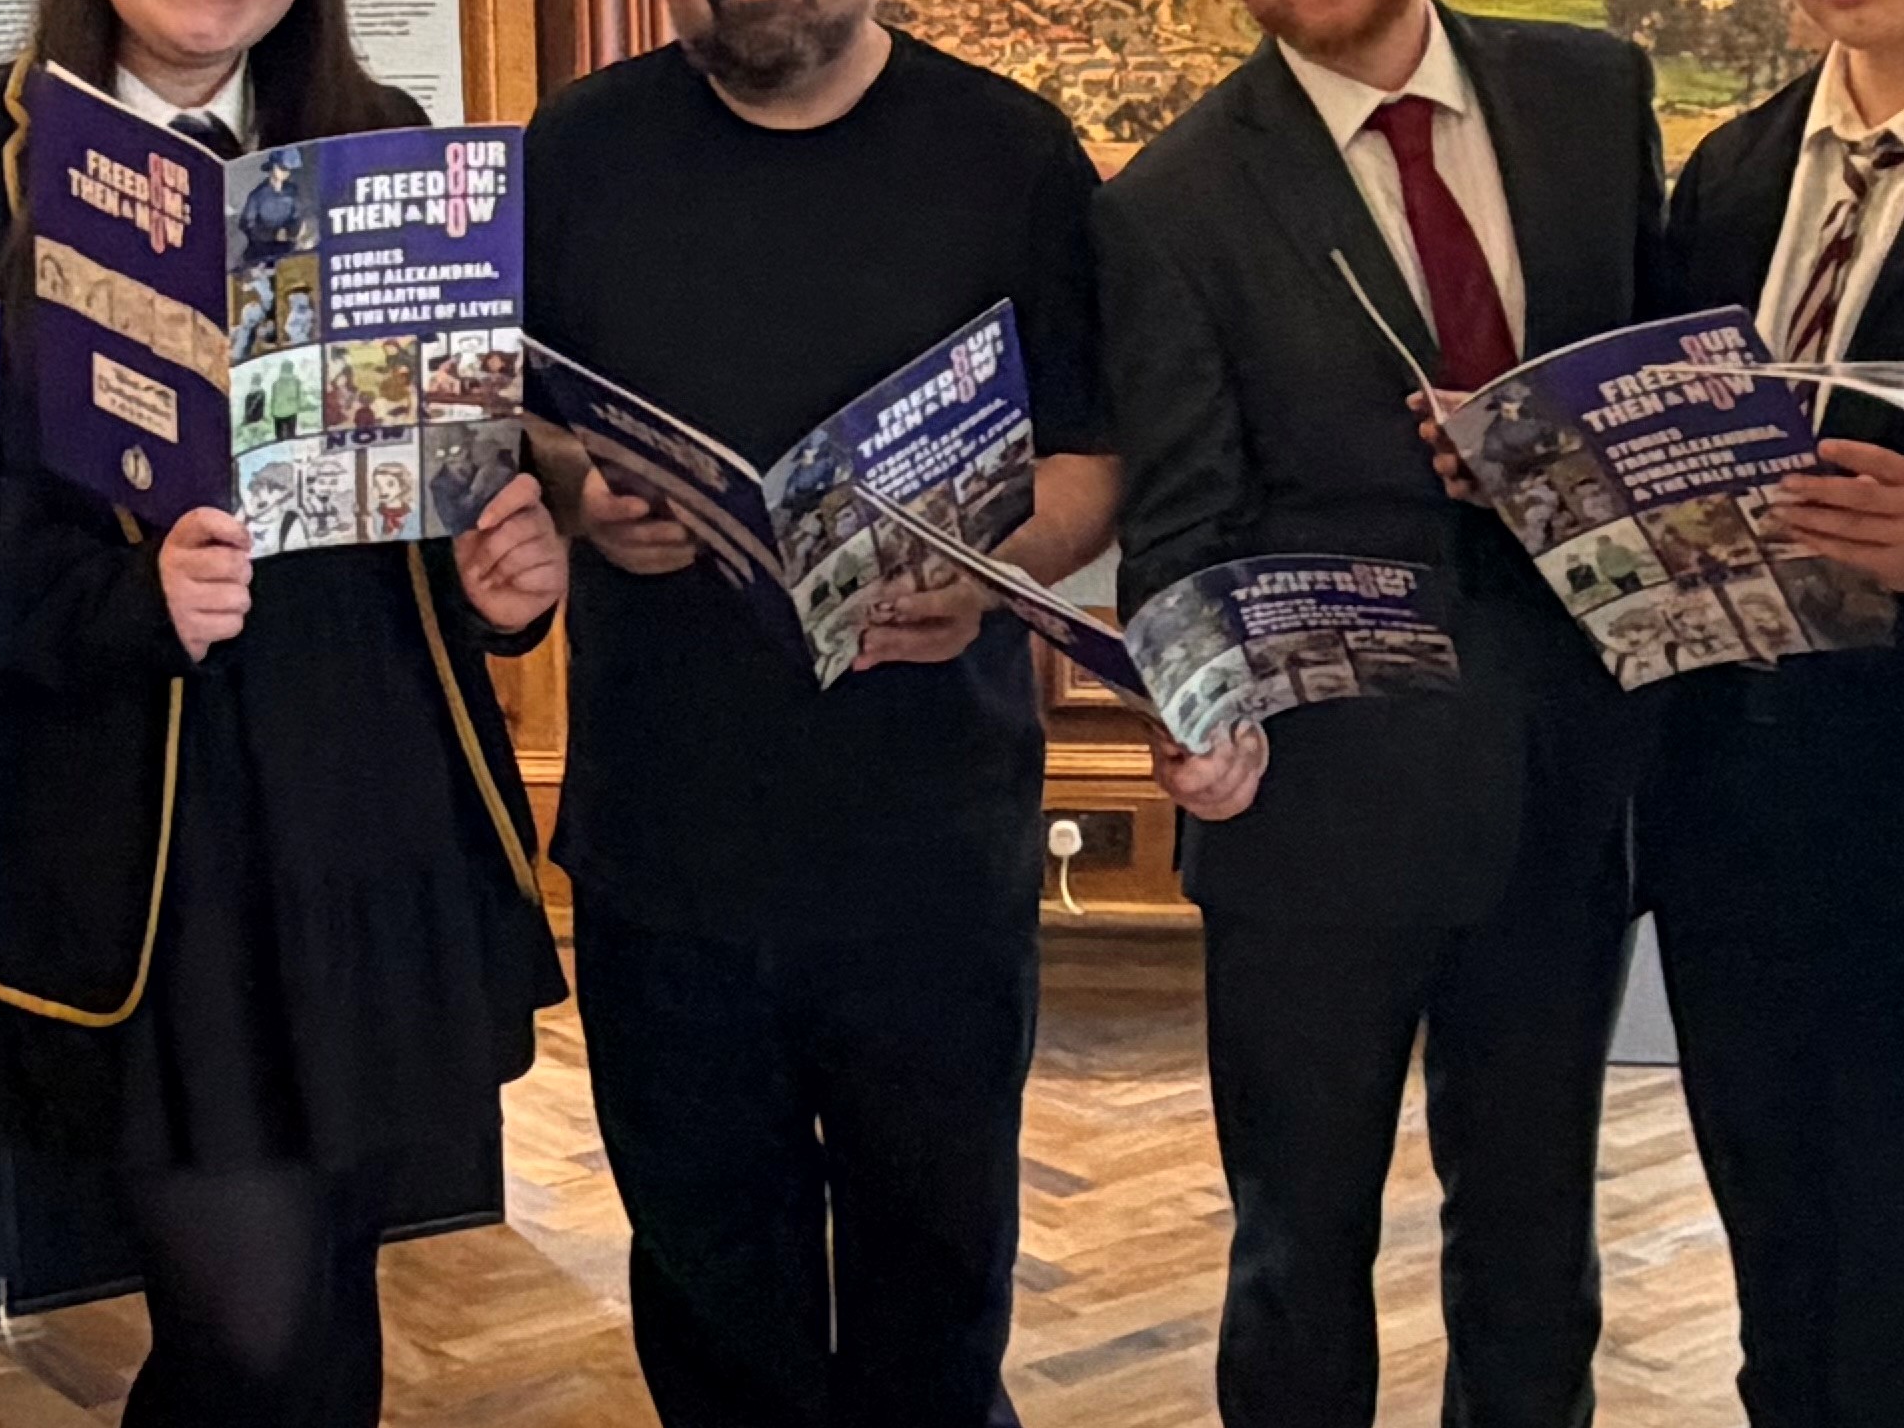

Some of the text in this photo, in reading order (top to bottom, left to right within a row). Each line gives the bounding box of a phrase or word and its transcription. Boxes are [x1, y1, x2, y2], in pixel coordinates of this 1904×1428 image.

[149, 152, 190, 195] OUR
[445, 140, 506, 168] OUR
[355, 169, 507, 203] FREEDOM:
[66, 167, 120, 217] THEN
[136, 201, 184, 254] NOW
[328, 196, 496, 238] THEN & NOW
[1679, 326, 1747, 357] OUR
[1582, 392, 1666, 432] THEN
[1682, 374, 1755, 410] NOW
